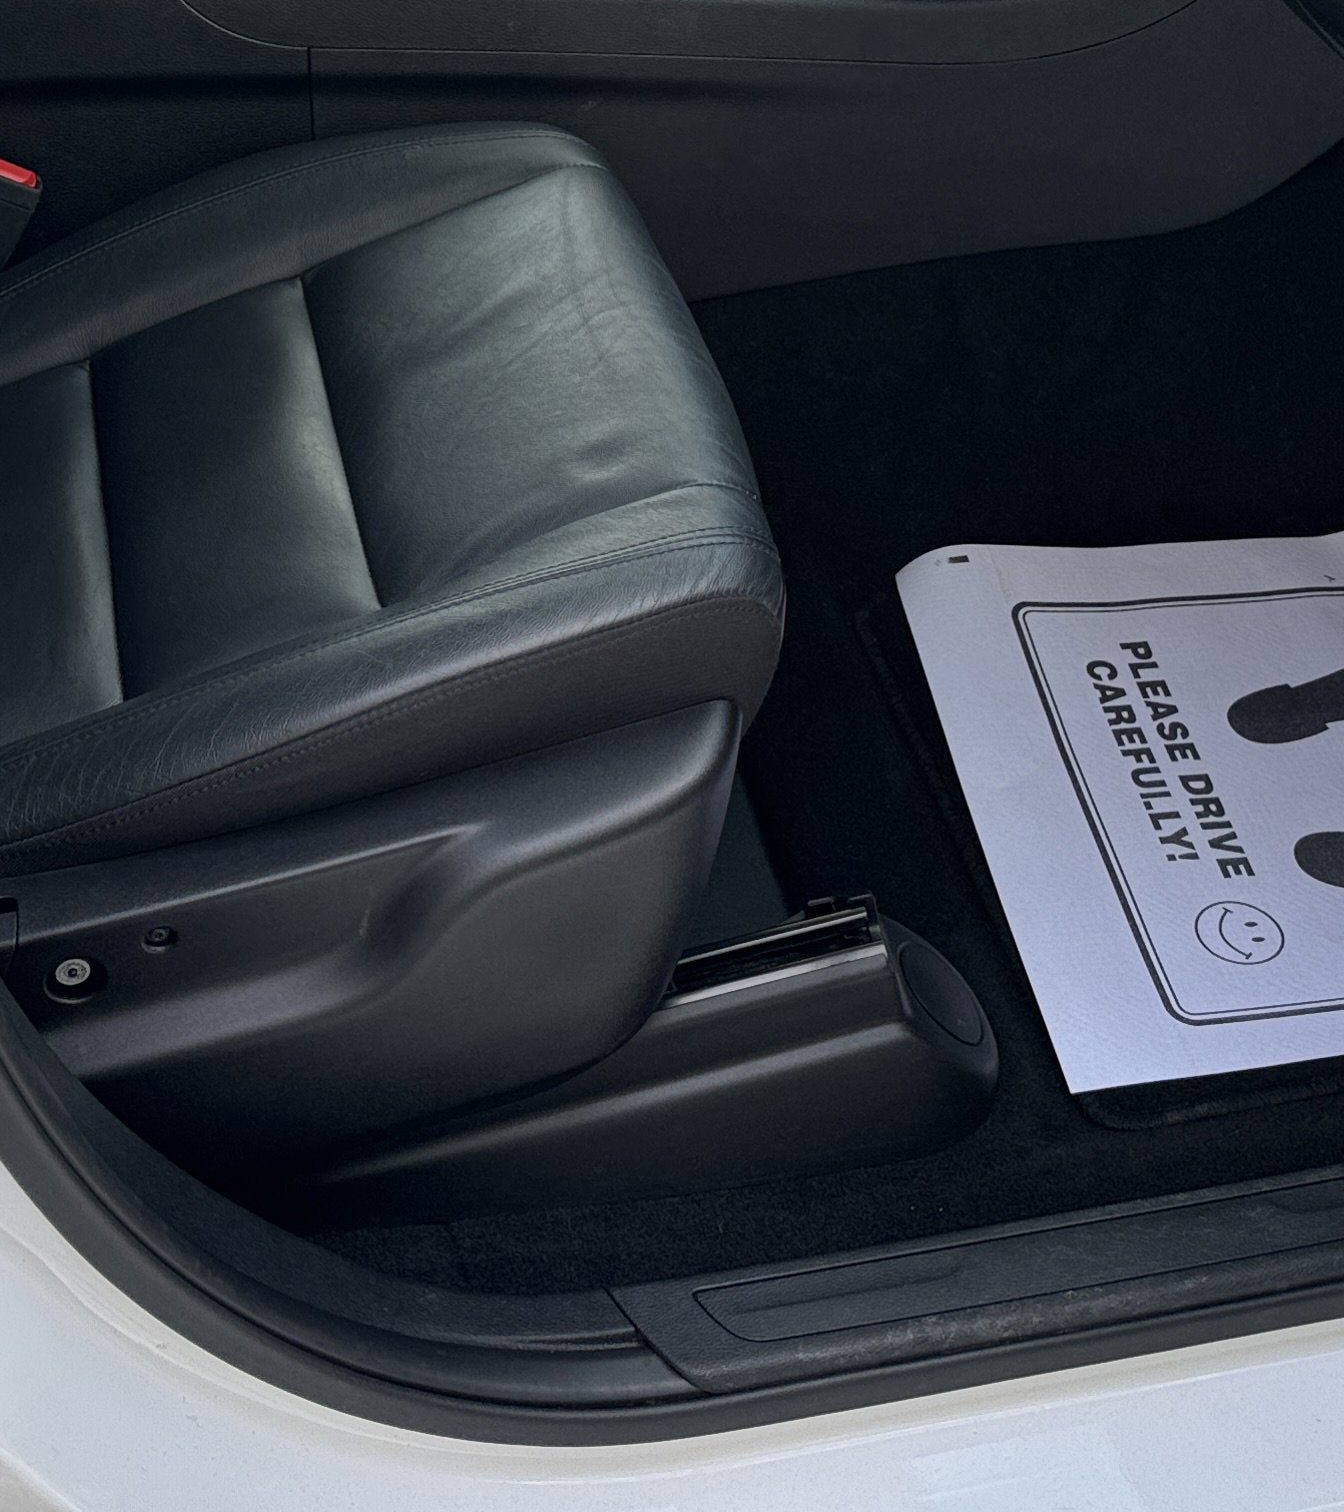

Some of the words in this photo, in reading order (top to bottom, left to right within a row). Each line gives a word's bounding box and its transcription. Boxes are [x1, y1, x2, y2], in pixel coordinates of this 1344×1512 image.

[1086, 660, 1201, 862] CAREFULLY!
[1119, 640, 1201, 762] PLEASE
[1178, 773, 1256, 879] DRIVE
